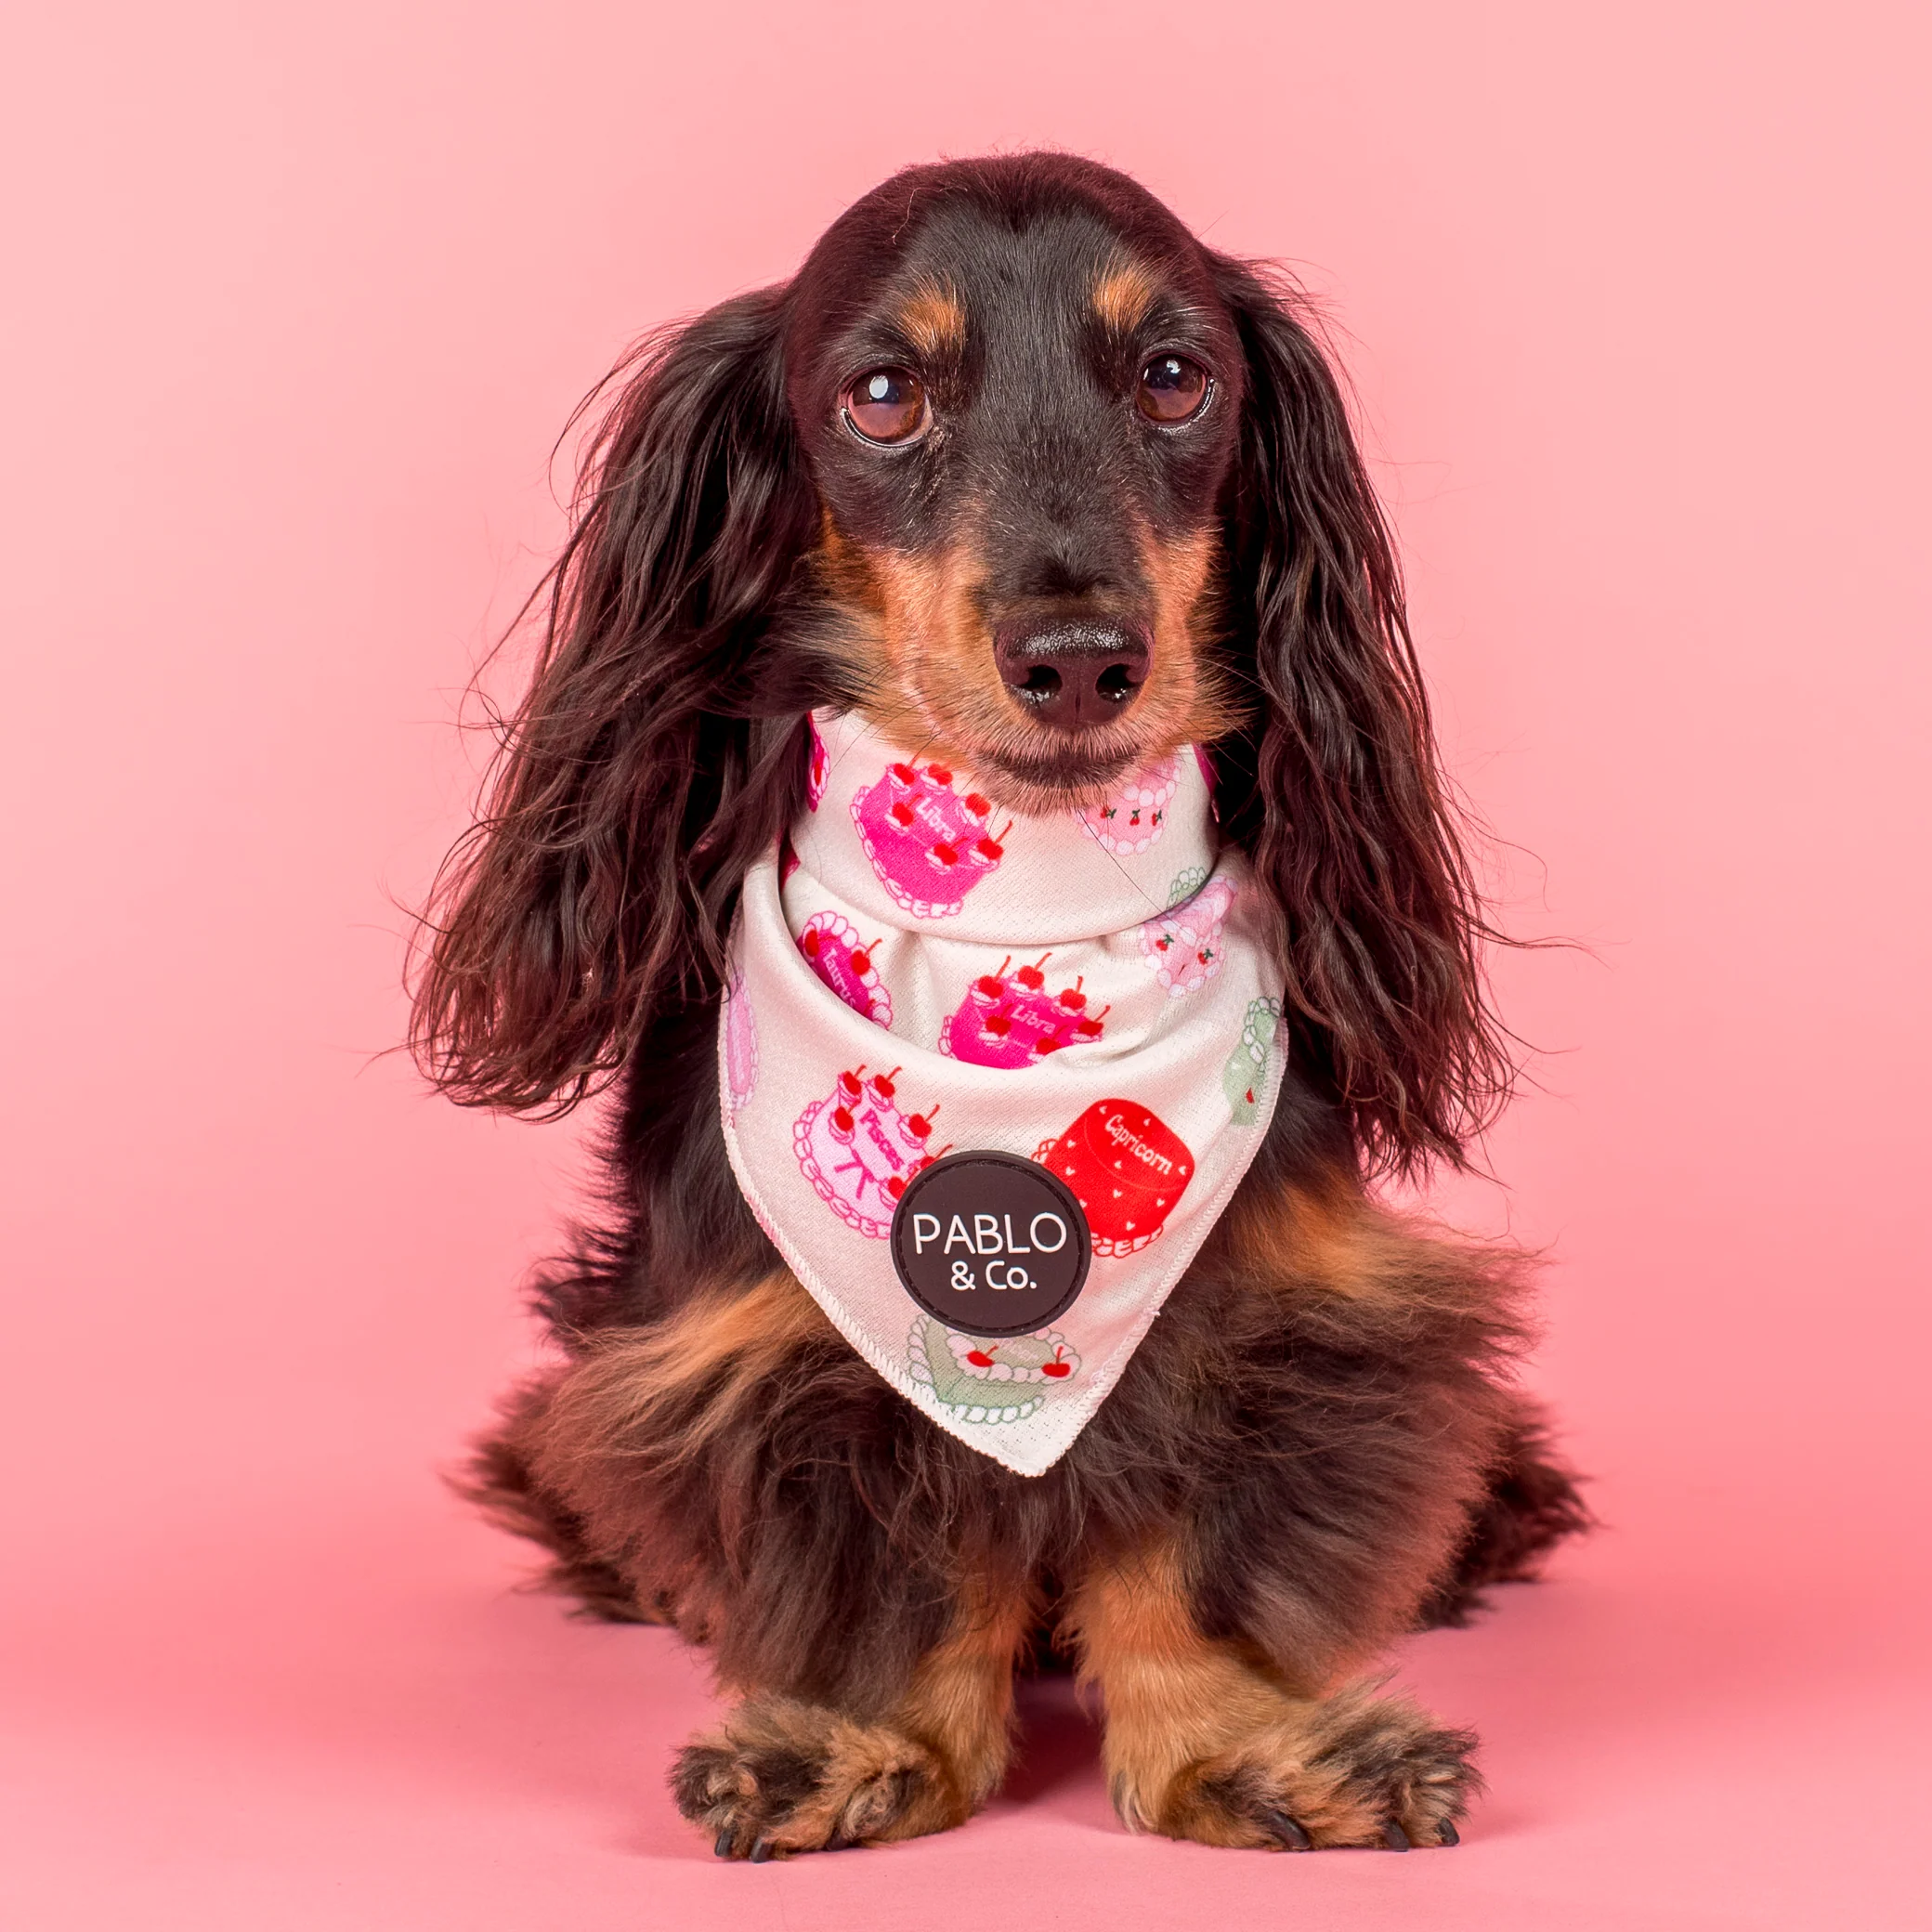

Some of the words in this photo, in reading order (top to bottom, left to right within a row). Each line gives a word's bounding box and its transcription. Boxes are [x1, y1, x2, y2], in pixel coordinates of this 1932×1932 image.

[915, 797, 957, 842] Libra
[823, 947, 856, 1008] Taurus
[1010, 1004, 1057, 1035] Libra
[860, 1108, 905, 1172] Pisces
[1104, 1114, 1173, 1175] Capricorn
[913, 1212, 1067, 1255] PABLO
[950, 1260, 976, 1291] &
[986, 1260, 1038, 1290] Co.
